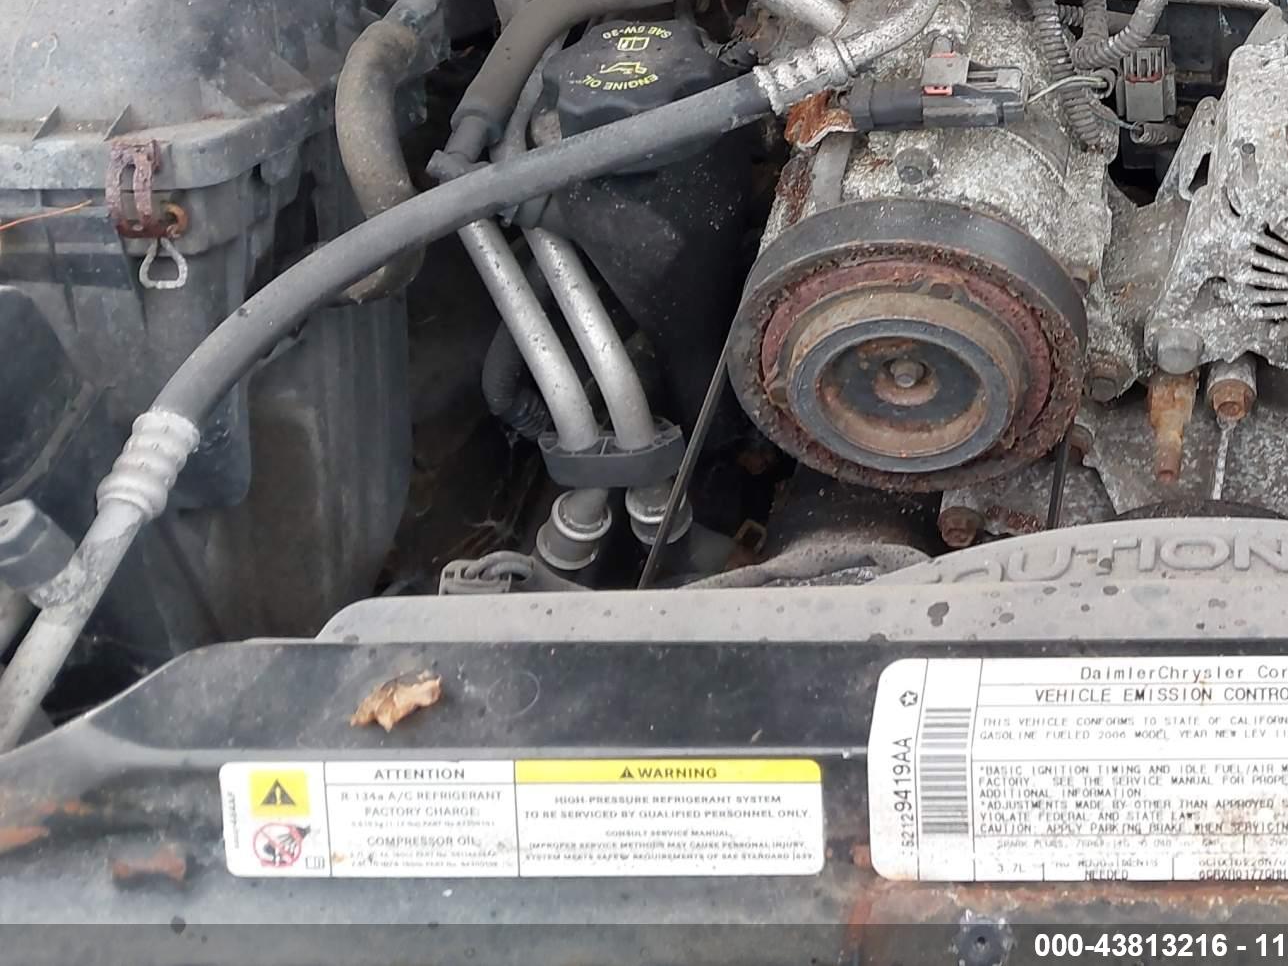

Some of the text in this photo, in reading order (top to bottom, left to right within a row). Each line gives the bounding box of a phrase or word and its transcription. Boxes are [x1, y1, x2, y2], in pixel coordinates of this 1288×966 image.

[647, 25, 673, 39] SAE
[582, 73, 659, 91] ENGINE OIL
[1080, 665, 1244, 683] DaimlerChrysler
[1034, 688, 1112, 703] VEHICLE
[1122, 687, 1212, 703] EMISSION
[373, 768, 465, 780] ATTENTION
[637, 767, 717, 779] WARNING
[386, 791, 414, 802] A/C
[416, 790, 502, 801] REFRIGERANT
[652, 795, 732, 804] REFRIGERANT
[736, 795, 782, 803] SYSTEM
[980, 788, 1050, 799] ADDITIONAL
[364, 806, 422, 817] FACTORY
[366, 835, 454, 847] COMPRESSOR
